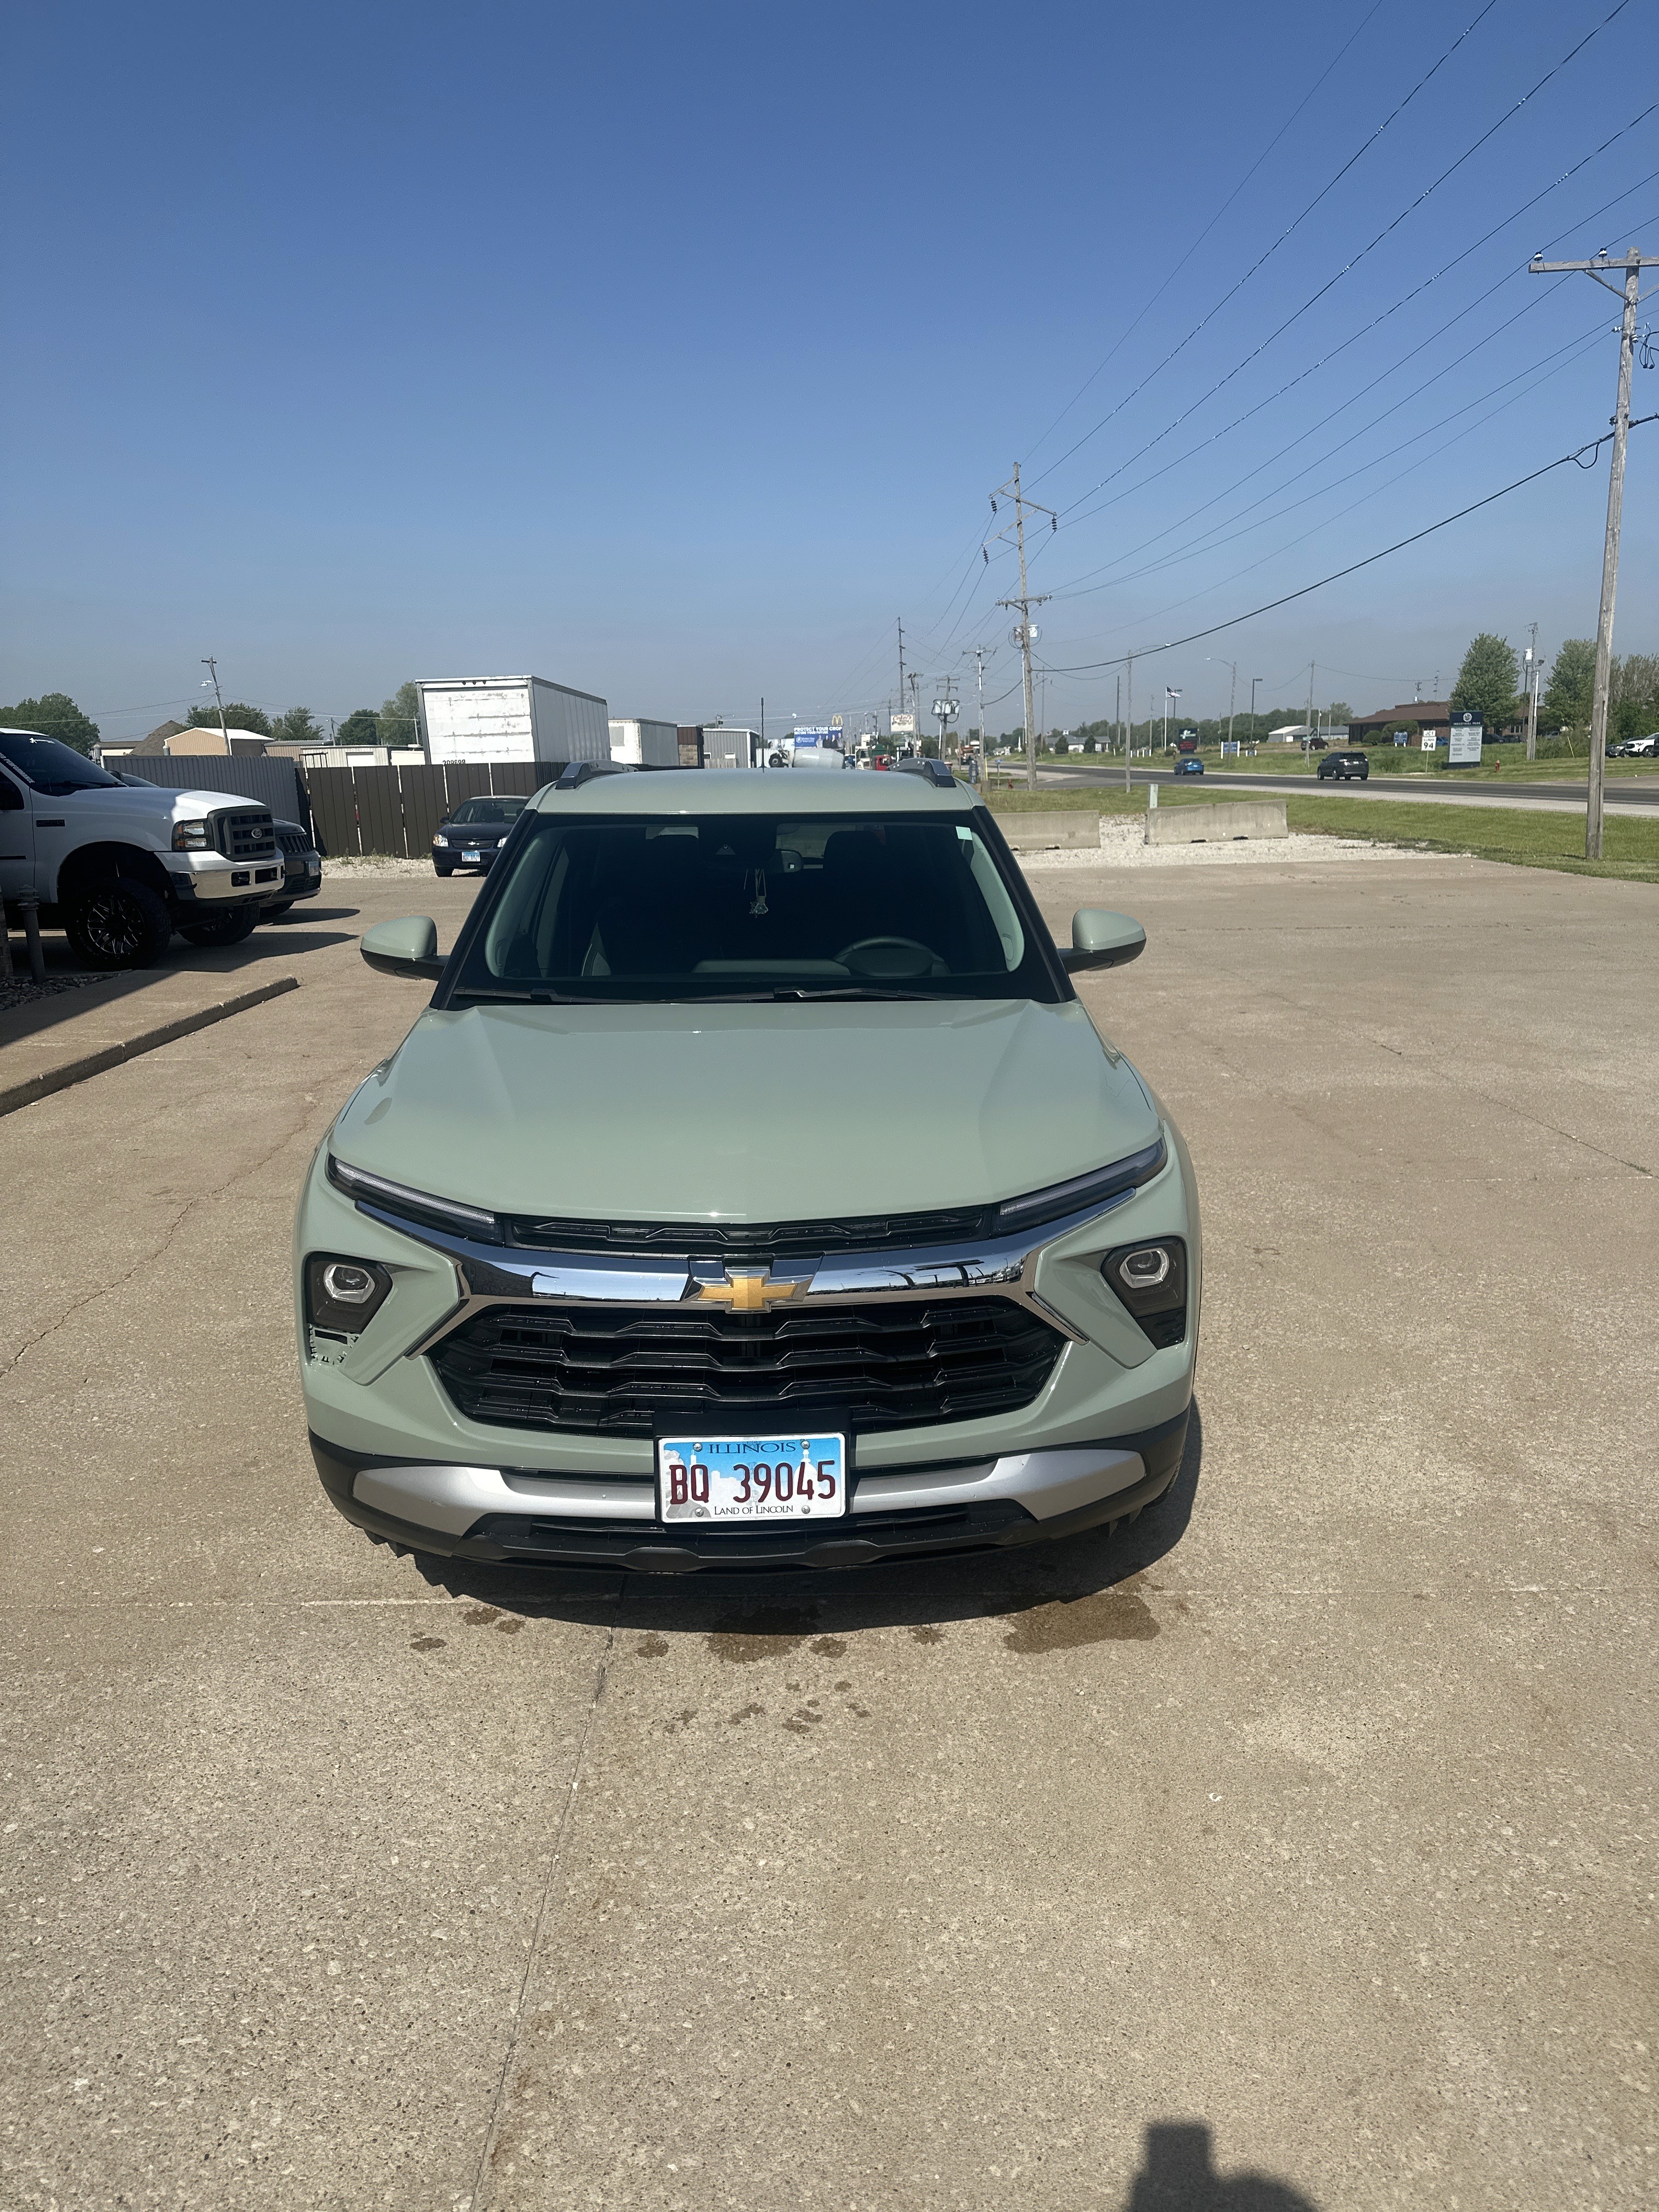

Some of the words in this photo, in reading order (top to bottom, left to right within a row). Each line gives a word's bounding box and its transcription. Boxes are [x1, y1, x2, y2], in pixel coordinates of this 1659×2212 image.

[709, 1442, 796, 1454] ILLINOIS
[669, 1464, 709, 1504] BQ
[733, 1460, 836, 1503] 39045
[714, 1506, 740, 1515] LAND
[756, 1505, 793, 1514] LINCOLN
